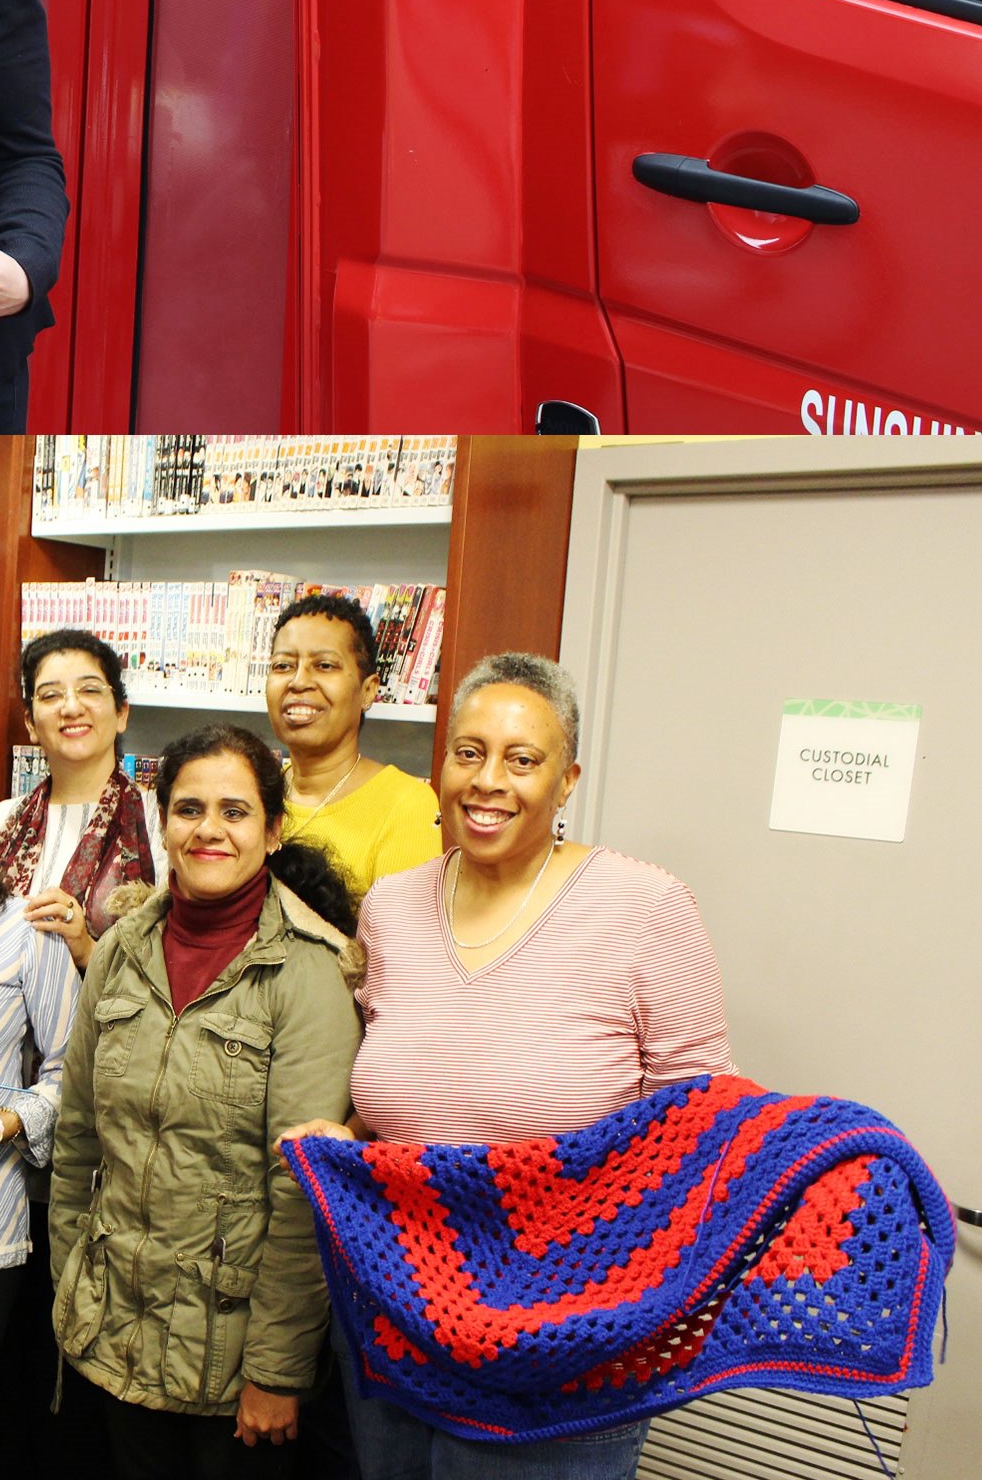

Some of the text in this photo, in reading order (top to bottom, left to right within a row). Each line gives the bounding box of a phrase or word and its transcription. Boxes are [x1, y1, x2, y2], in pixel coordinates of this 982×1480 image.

[414, 620, 434, 675] CRISIS GIRLS
[424, 620, 444, 676] CRISIS GIRLS
[800, 748, 890, 768] CUSTODIAL
[812, 768, 872, 784] CLOSET
